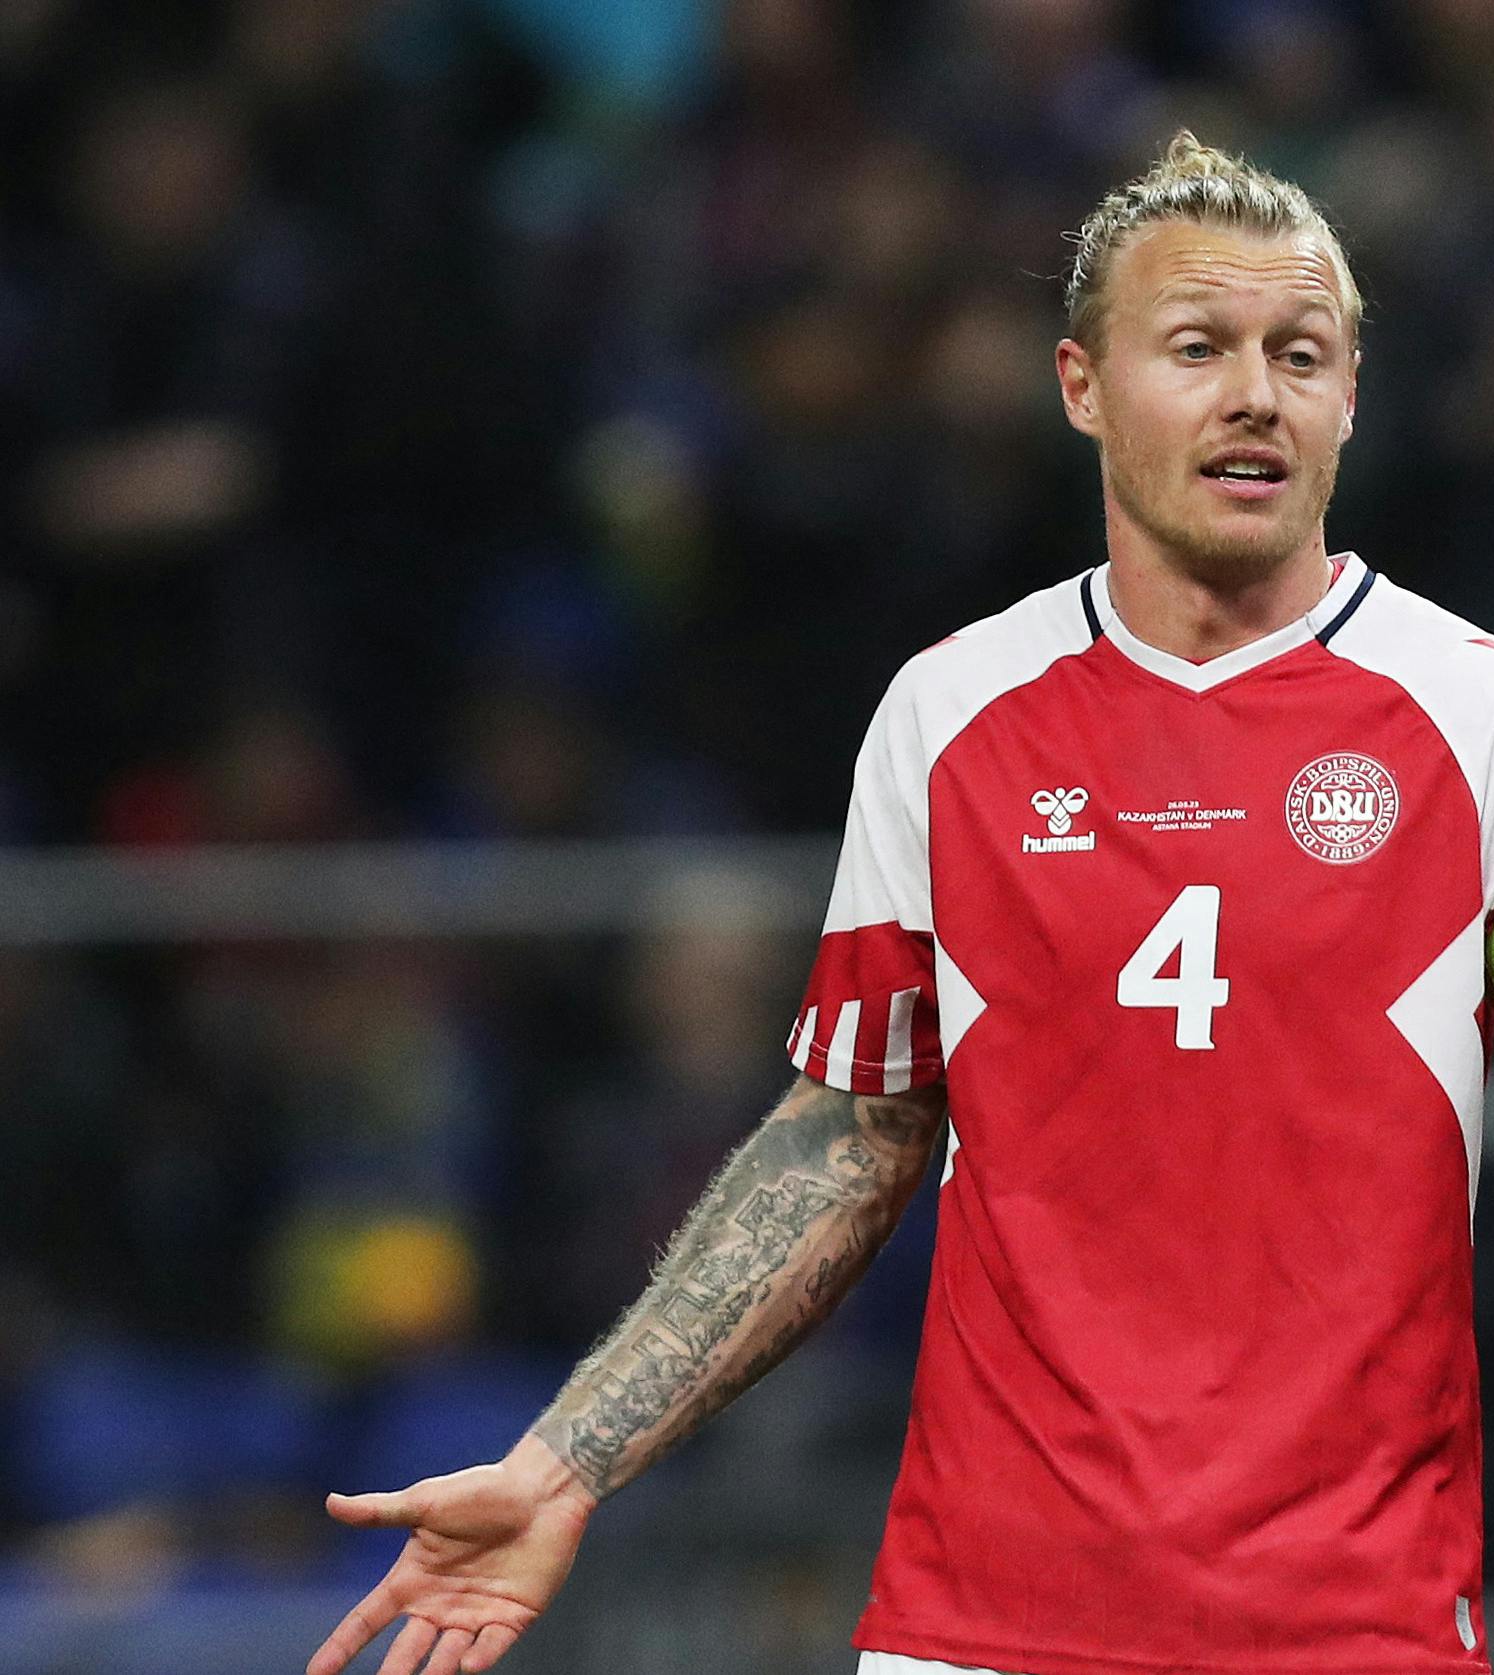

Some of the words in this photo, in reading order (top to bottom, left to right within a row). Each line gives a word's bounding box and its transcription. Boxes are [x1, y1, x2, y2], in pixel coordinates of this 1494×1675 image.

[1117, 810, 1185, 822] KAZAKHSTAN
[1195, 809, 1247, 821] DENMARK
[1290, 784, 1316, 848] DANSK
[1369, 786, 1396, 845] UNION
[1309, 789, 1376, 822] DBU
[1022, 830, 1095, 853] hummel
[1117, 885, 1230, 1050] 4
